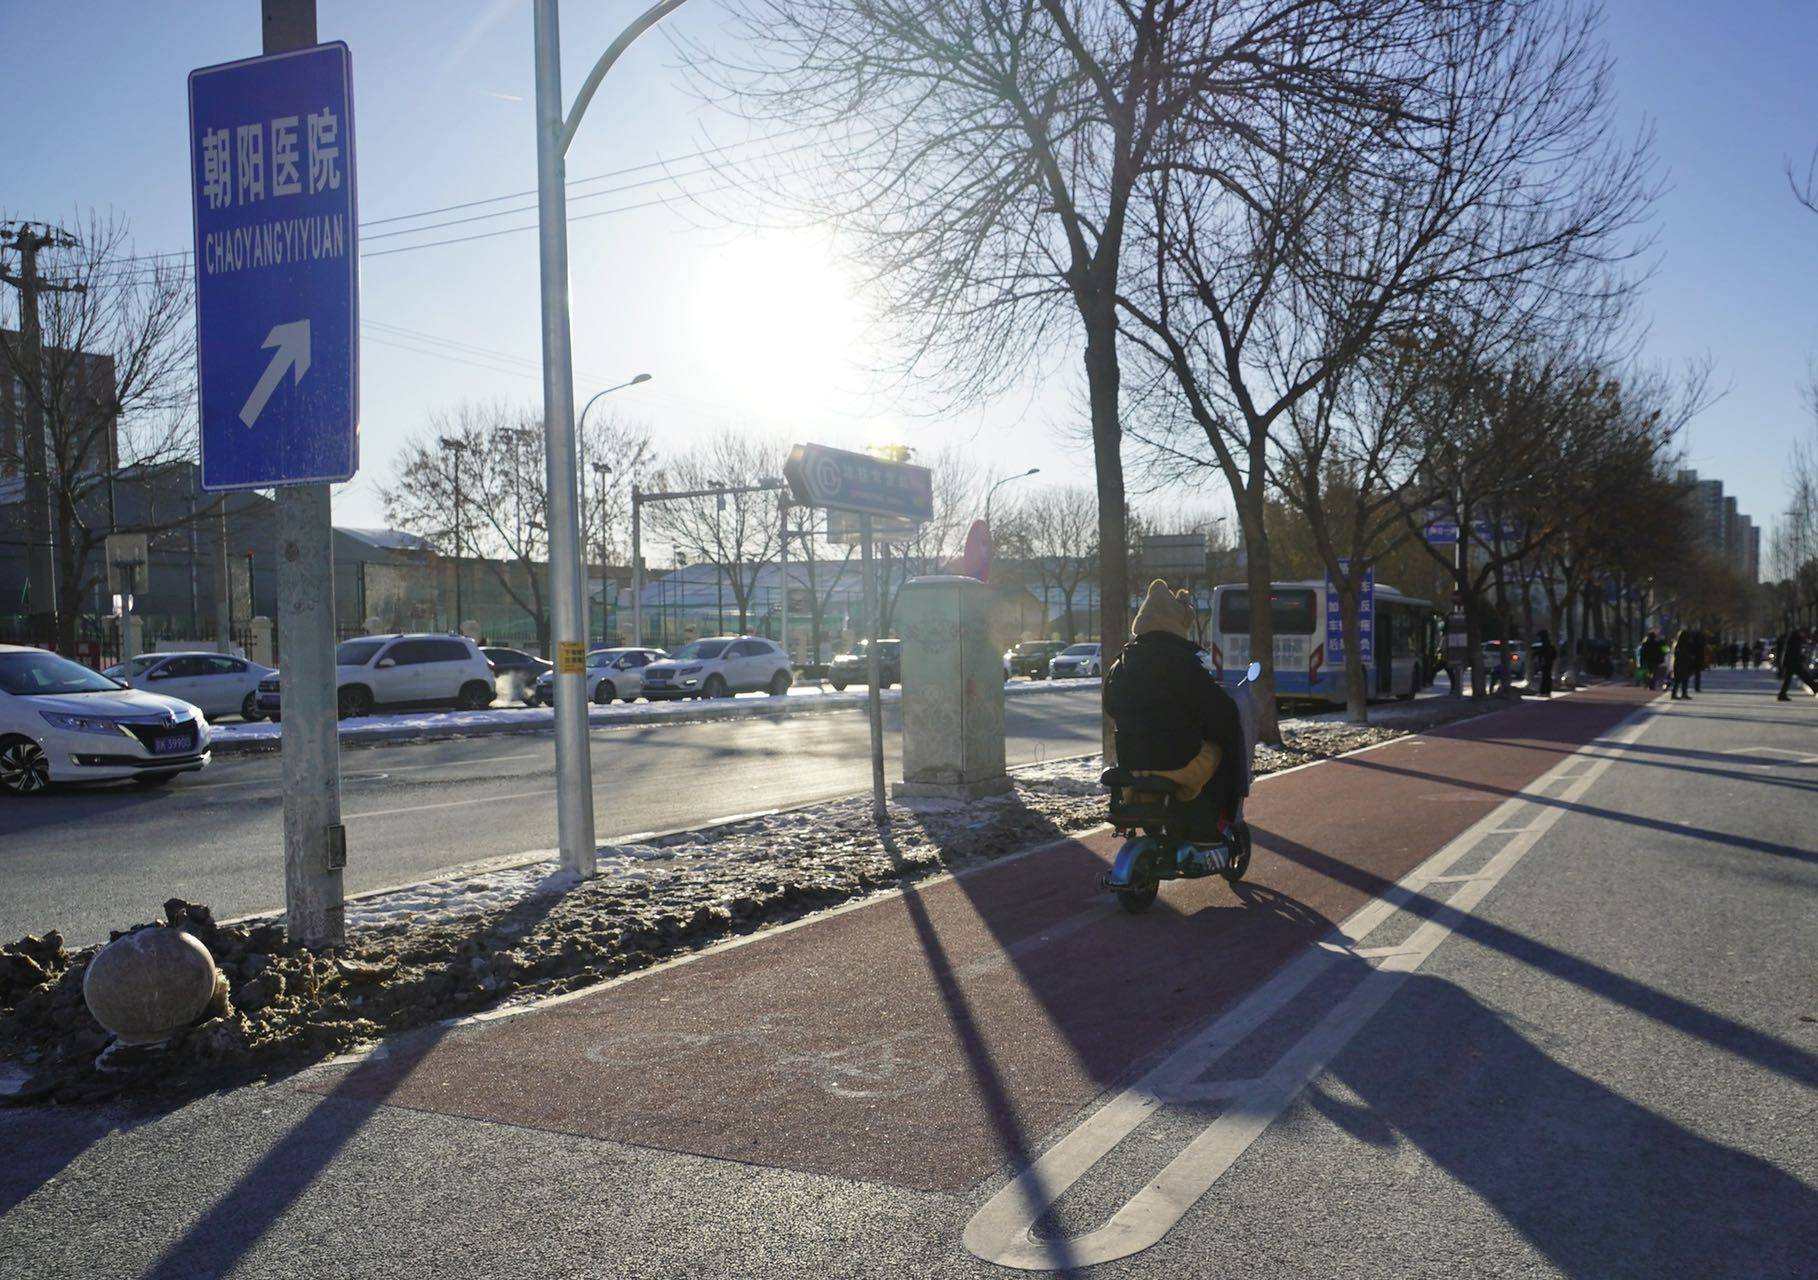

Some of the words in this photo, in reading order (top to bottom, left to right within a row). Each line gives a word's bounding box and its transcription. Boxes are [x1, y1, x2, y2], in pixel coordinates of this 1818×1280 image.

[202, 106, 341, 209] 朝阳医院
[205, 213, 343, 275] CHAOYANGYIYUAN
